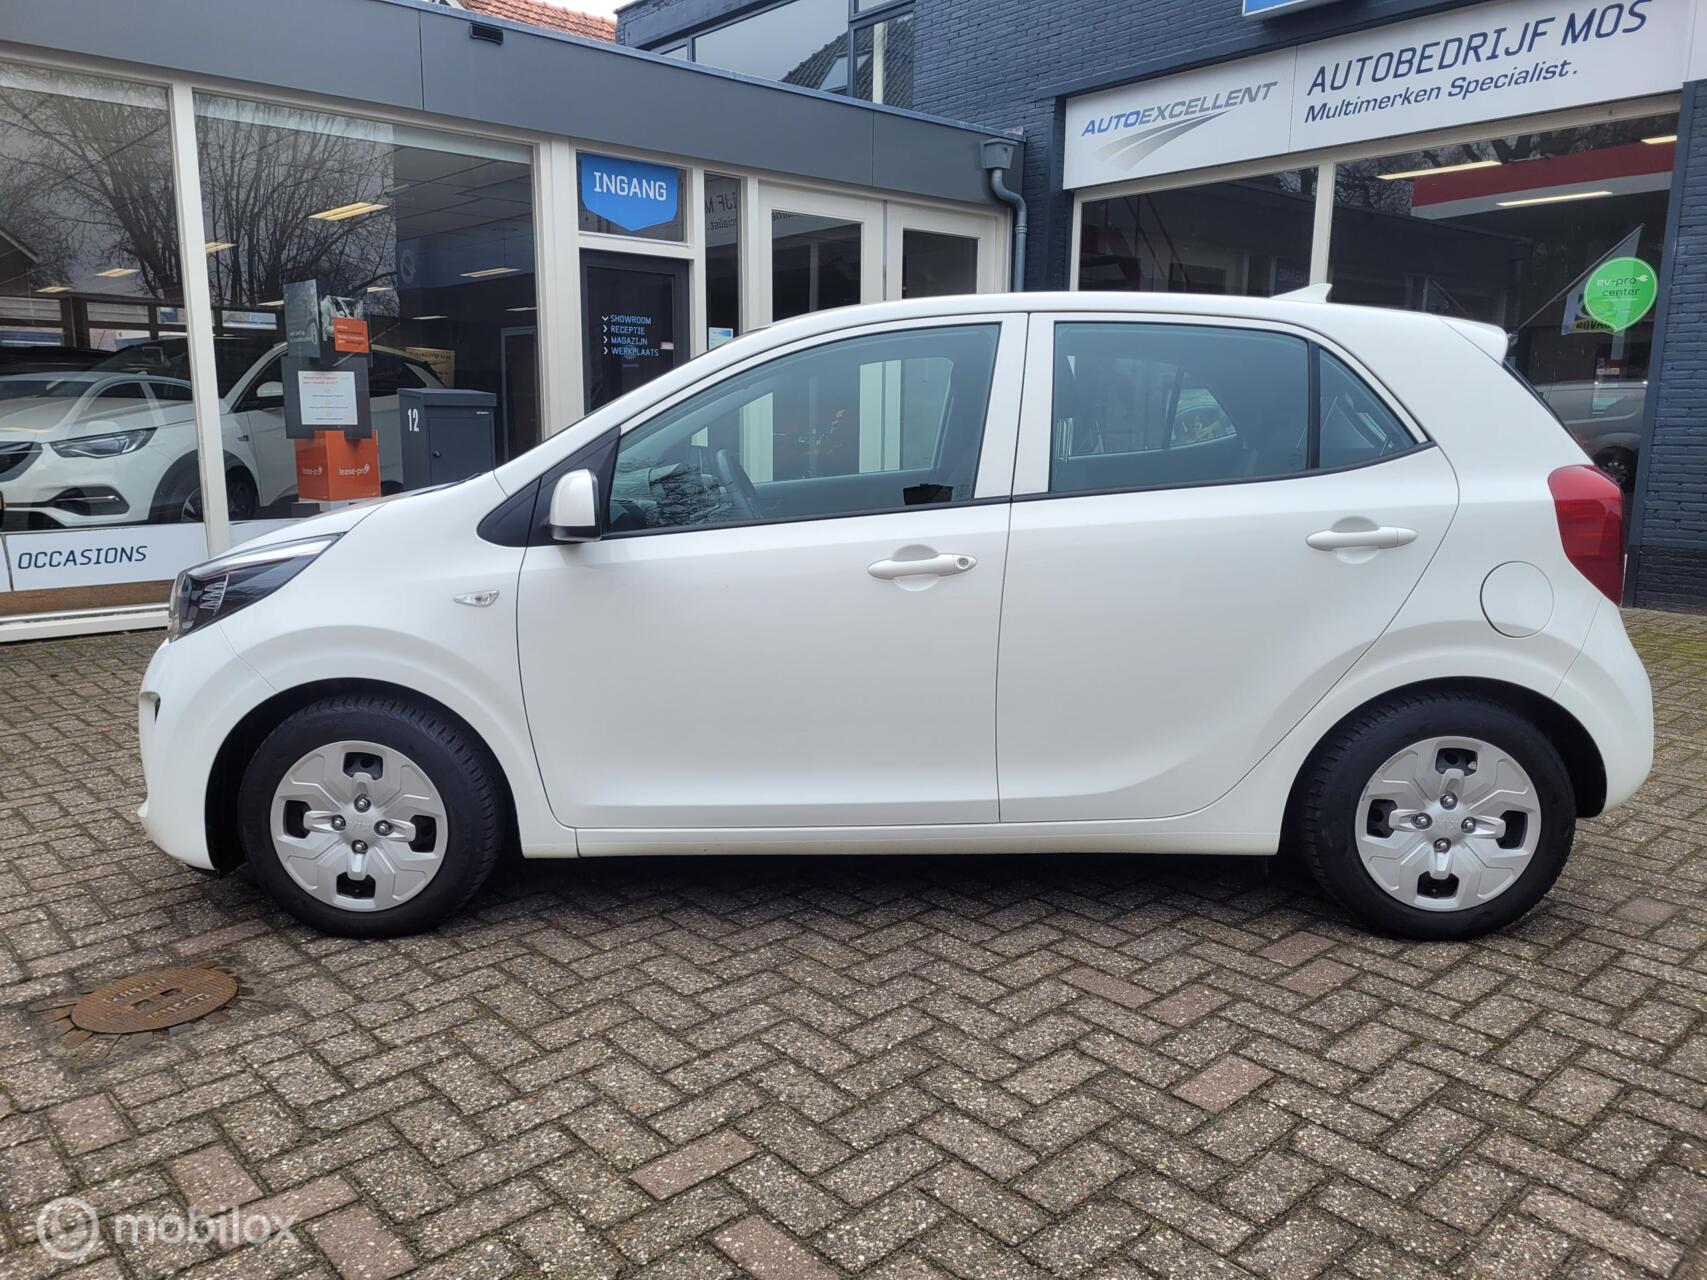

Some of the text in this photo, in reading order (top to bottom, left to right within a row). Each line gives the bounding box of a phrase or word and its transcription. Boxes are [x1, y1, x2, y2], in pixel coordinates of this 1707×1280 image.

[1307, 0, 1651, 96] AUTOBEDRIJF MOS
[1304, 59, 1578, 123] Multimerken Specialist.
[1081, 81, 1279, 137] AUTOEXCELLENT
[593, 171, 667, 201] INGANG
[1596, 276, 1637, 287] ev-pro
[1602, 288, 1641, 297] center
[610, 314, 652, 325] SHOWROOM
[610, 325, 645, 335] RECEPTIE
[611, 336, 648, 346] MAGAZIJN
[611, 346, 660, 357] WERKPLAATS
[407, 408, 420, 432] 12
[17, 545, 148, 570] OCCASIONS
